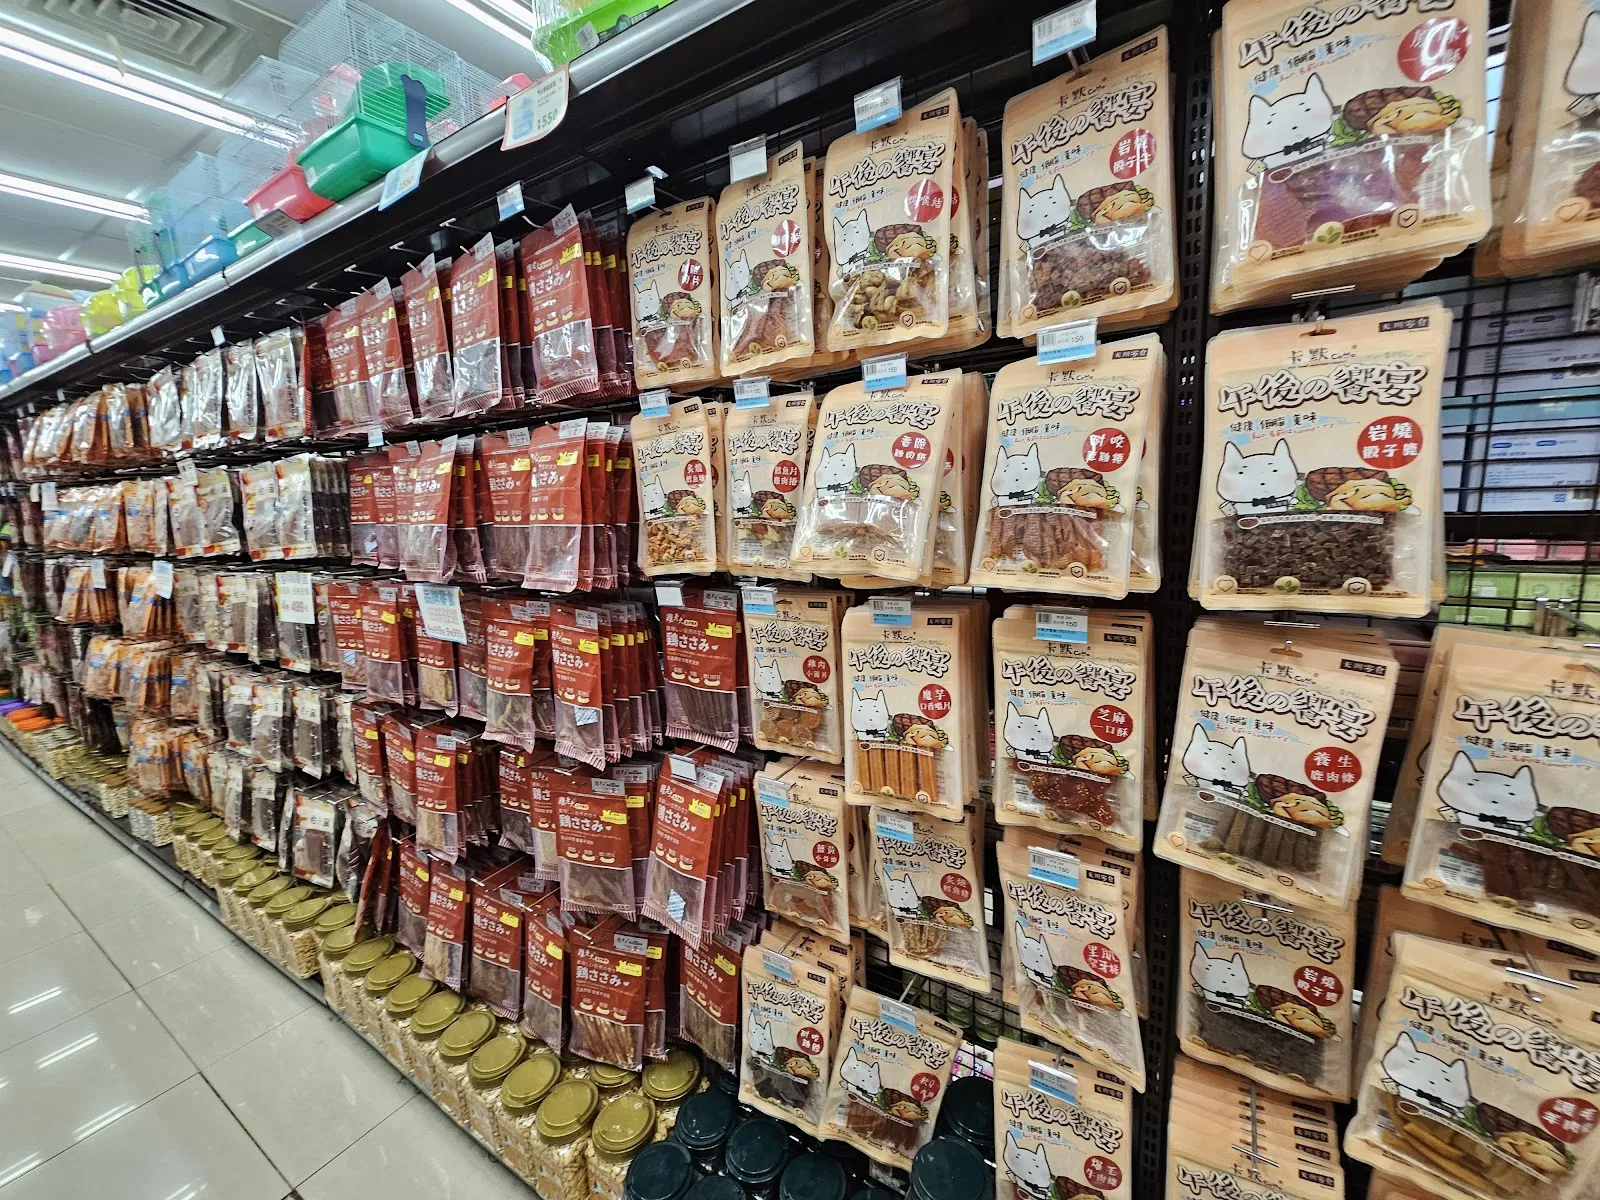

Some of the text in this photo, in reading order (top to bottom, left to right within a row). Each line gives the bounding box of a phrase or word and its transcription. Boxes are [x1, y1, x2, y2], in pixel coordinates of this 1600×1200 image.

[1011, 81, 1158, 166] 午後の饗宴
[829, 141, 946, 198] 午後の饗宴
[997, 384, 1141, 426] 午後の饗宴
[1217, 361, 1428, 418] 午後の饗宴
[824, 402, 941, 430] 午後の饗宴
[1368, 422, 1413, 442] 岩燒
[751, 622, 828, 652] 午後の饗宴
[848, 642, 952, 678] 午後の饗宴
[1002, 655, 1136, 700] 午後の饗宴
[1257, 661, 1294, 680] 卡默
[1093, 724, 1129, 738] 一口酥
[1097, 708, 1126, 725] 芝麻
[1192, 675, 1376, 744] 午後の饗宴
[1313, 752, 1353, 768] 養生
[1006, 880, 1118, 940] 午後の饗宴
[1188, 897, 1346, 966] 午後の饗宴
[850, 1016, 950, 1070] 午後の饗宴
[1002, 1088, 1124, 1154] 午後の饗宴
